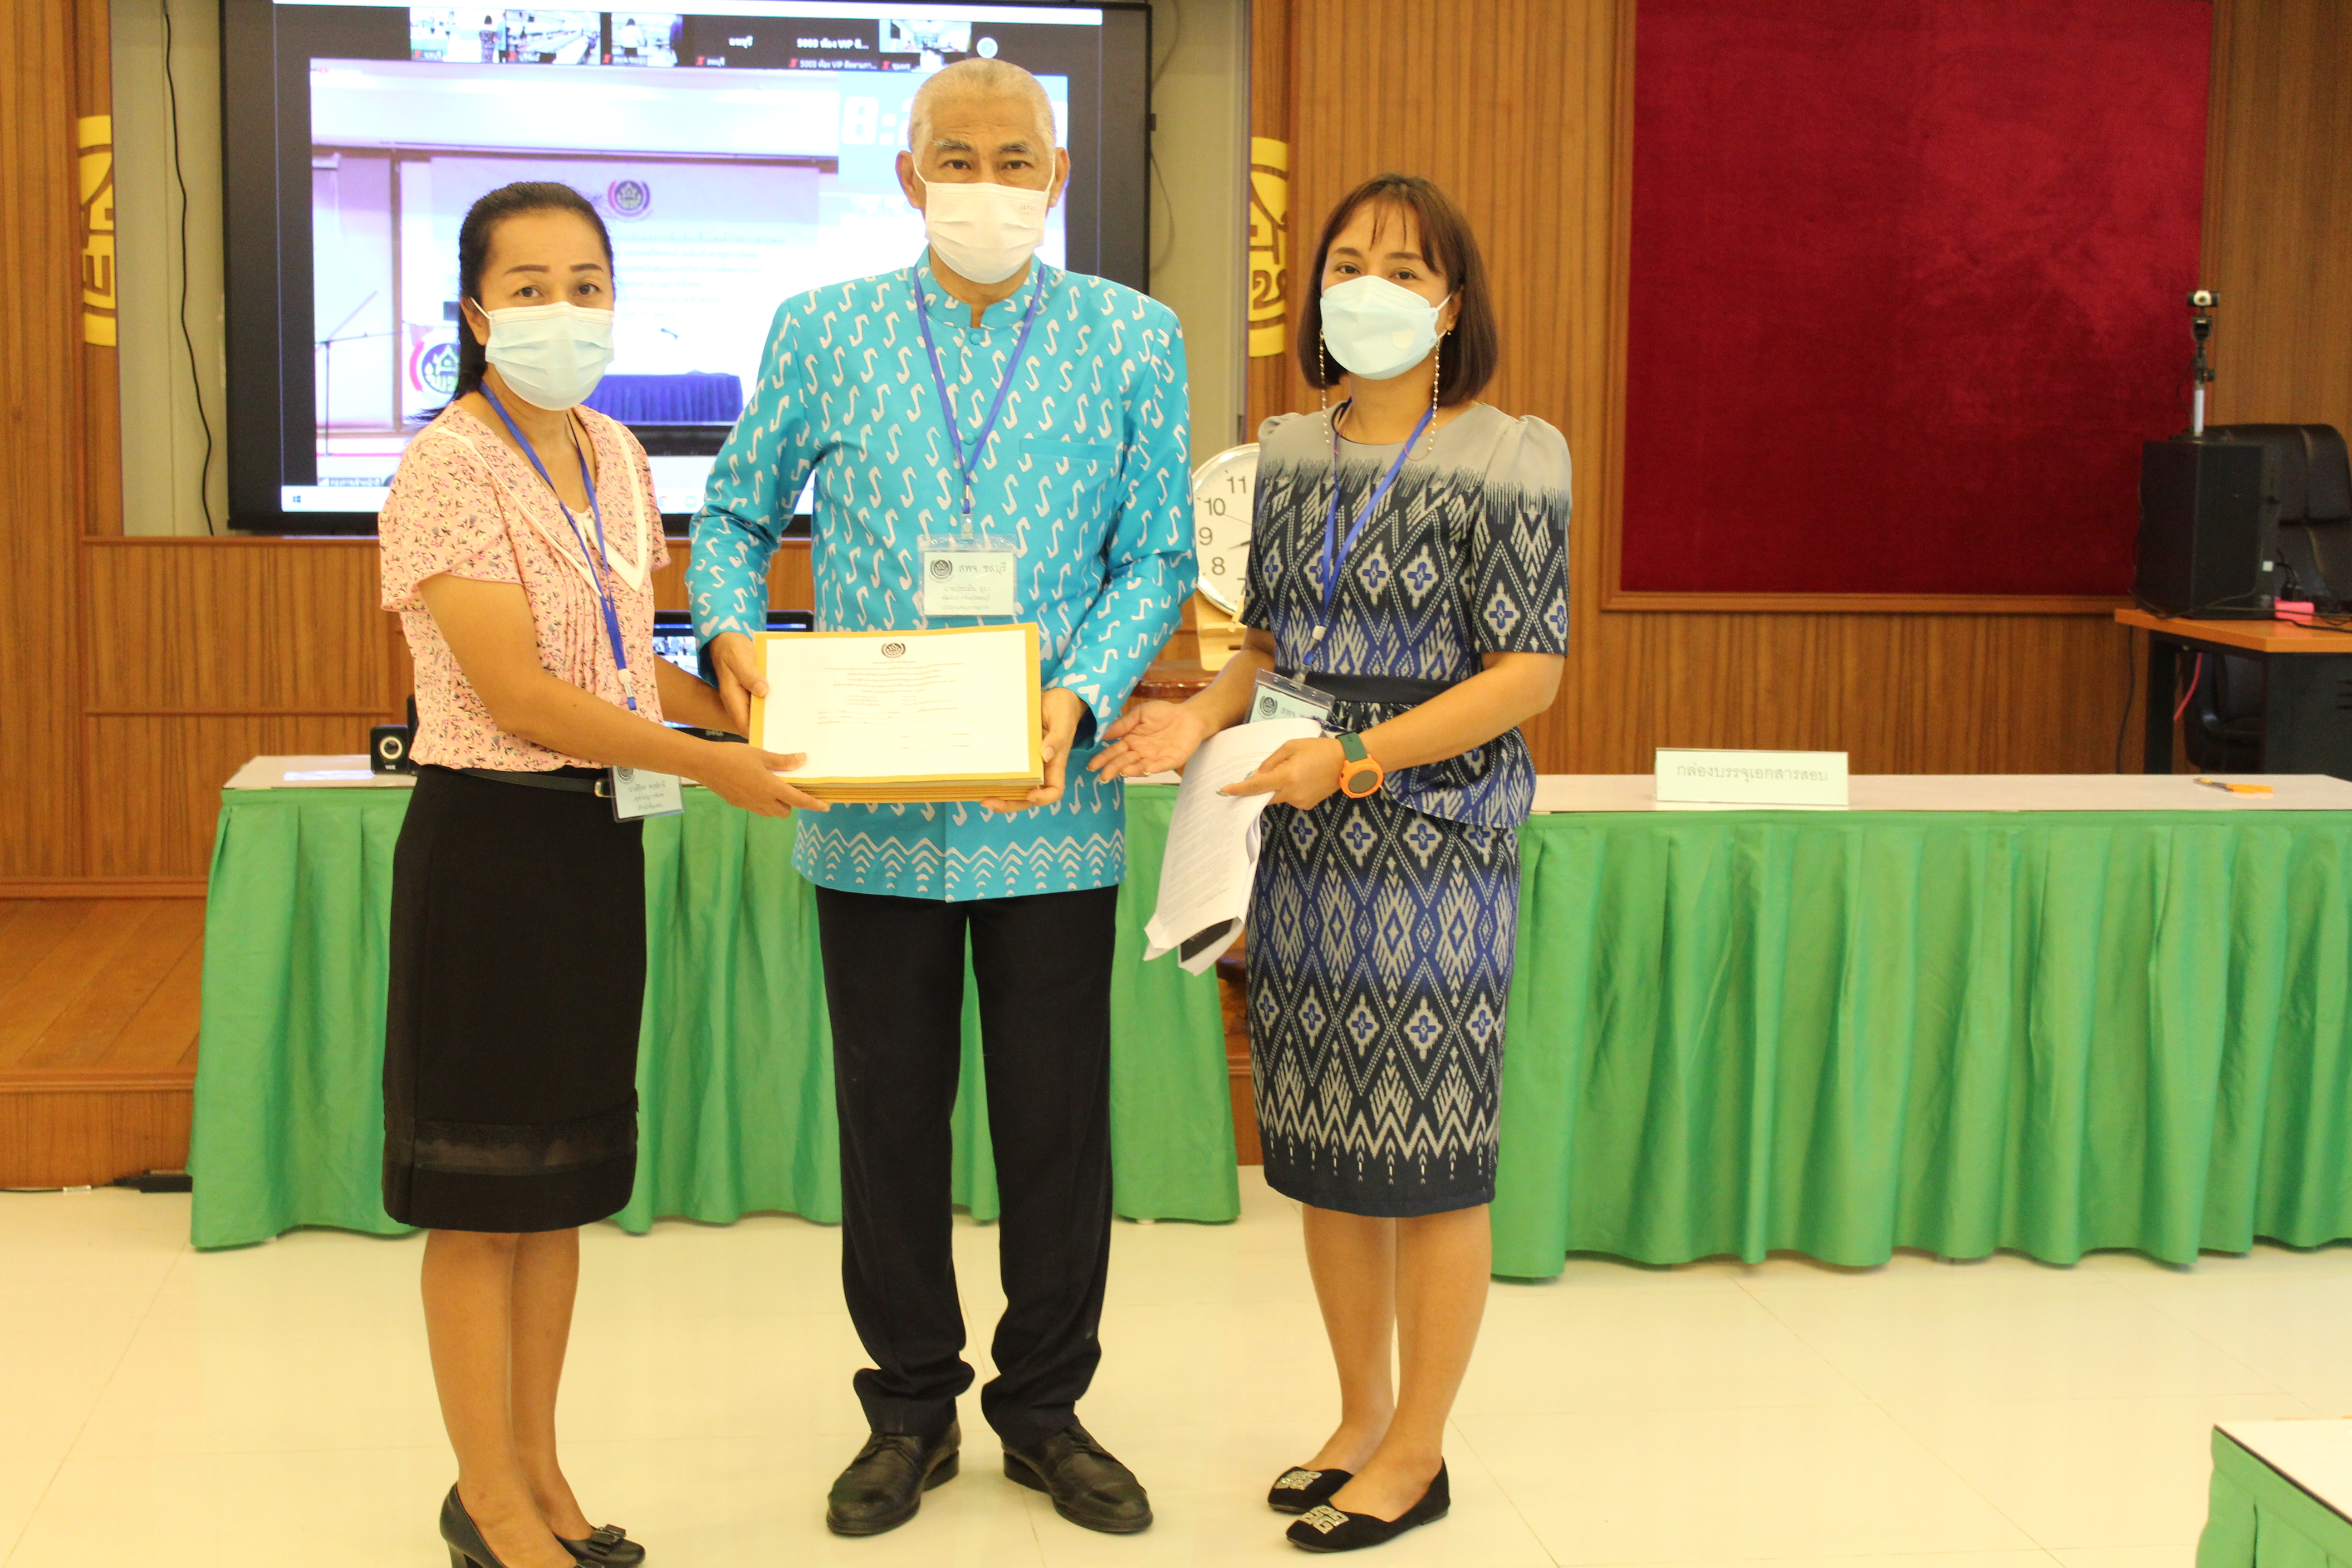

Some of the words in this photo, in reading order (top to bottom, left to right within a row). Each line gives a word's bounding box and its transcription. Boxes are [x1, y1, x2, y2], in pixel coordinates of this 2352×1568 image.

[1226, 476, 1246, 494] 11
[1204, 498, 1225, 516] 10
[1199, 527, 1213, 546] 9
[1212, 557, 1225, 575] 8
[1677, 762, 1828, 782] กล่องบรรจุเอกสารสอบ
